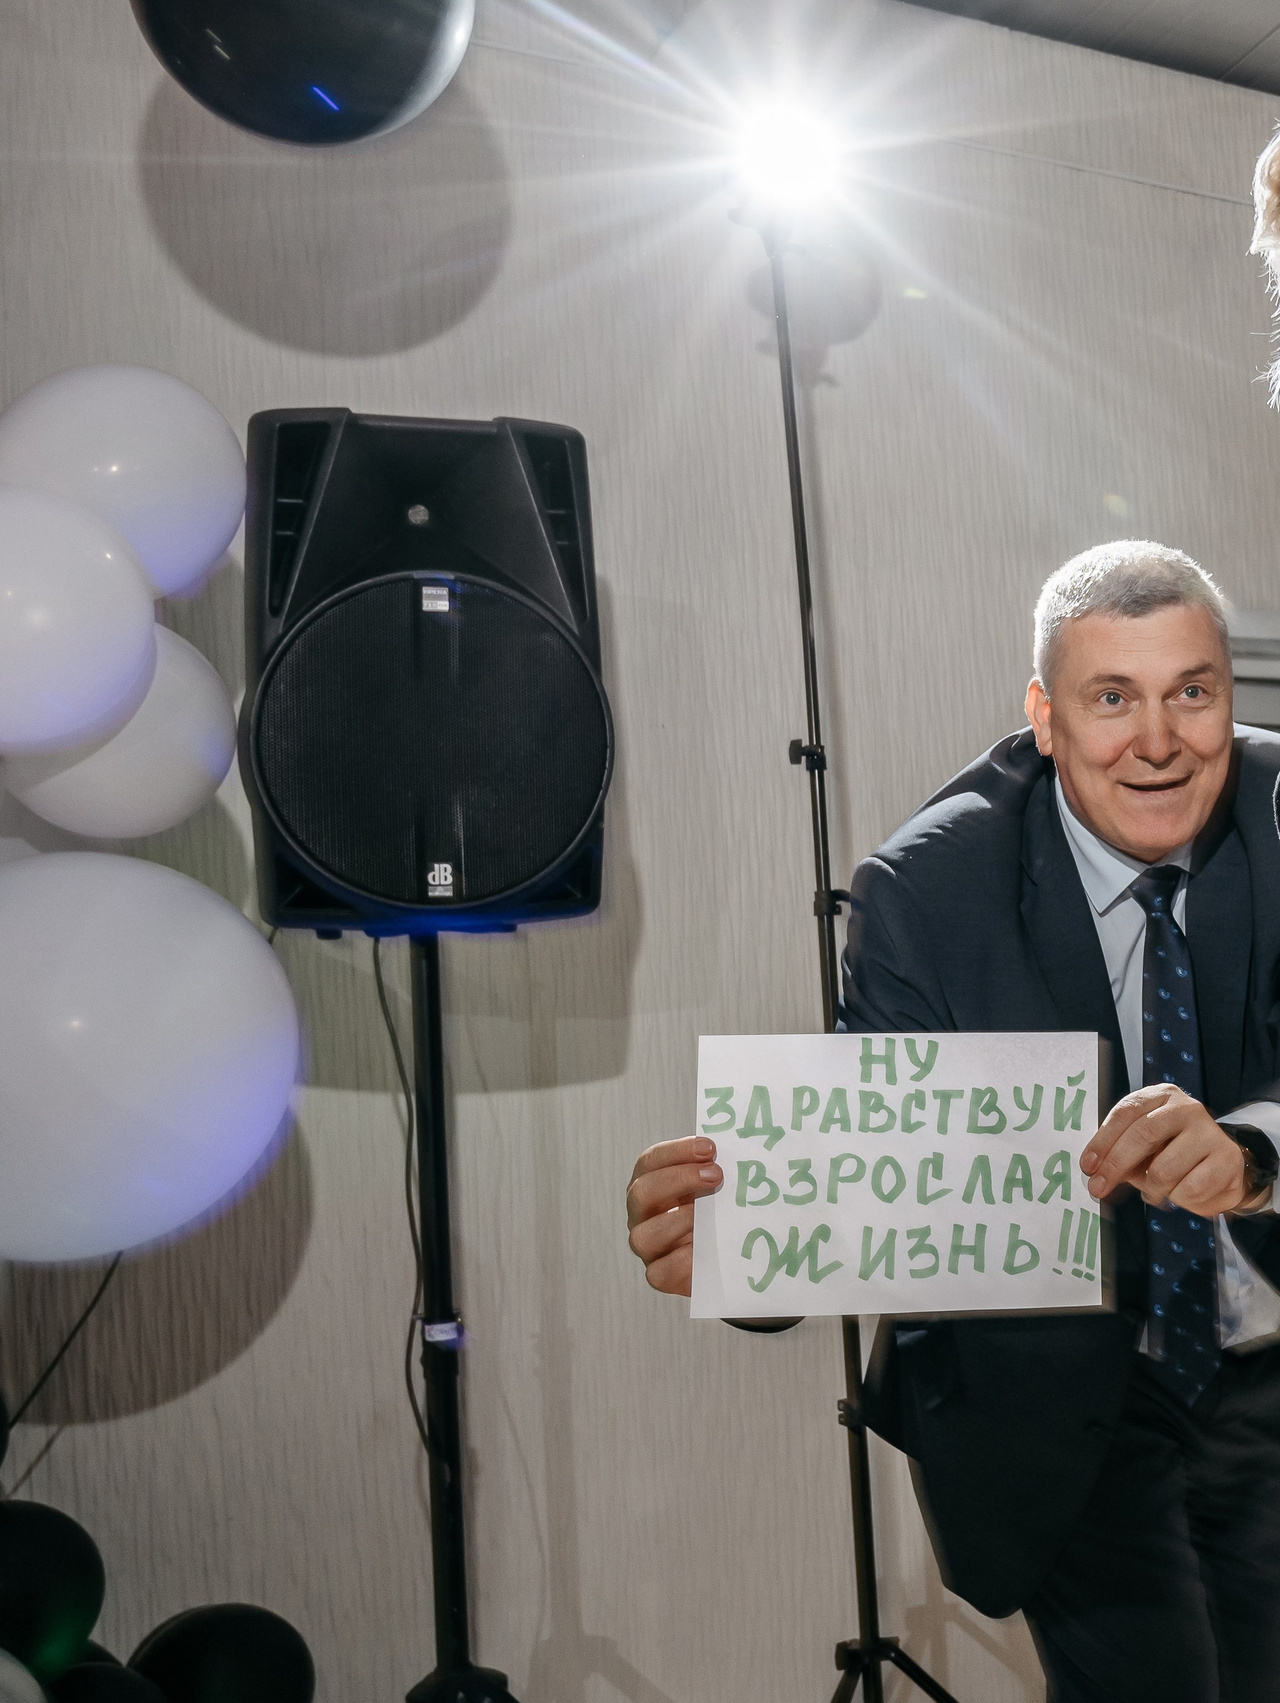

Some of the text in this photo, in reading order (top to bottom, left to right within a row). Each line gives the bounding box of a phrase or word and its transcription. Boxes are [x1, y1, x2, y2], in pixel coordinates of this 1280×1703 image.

[427, 863, 453, 885] dB
[859, 1036, 939, 1086] НУ
[701, 1069, 1087, 1151] ЗДРАВСТВУЙ
[735, 1150, 1071, 1207] ВЗРОСЛАЯ
